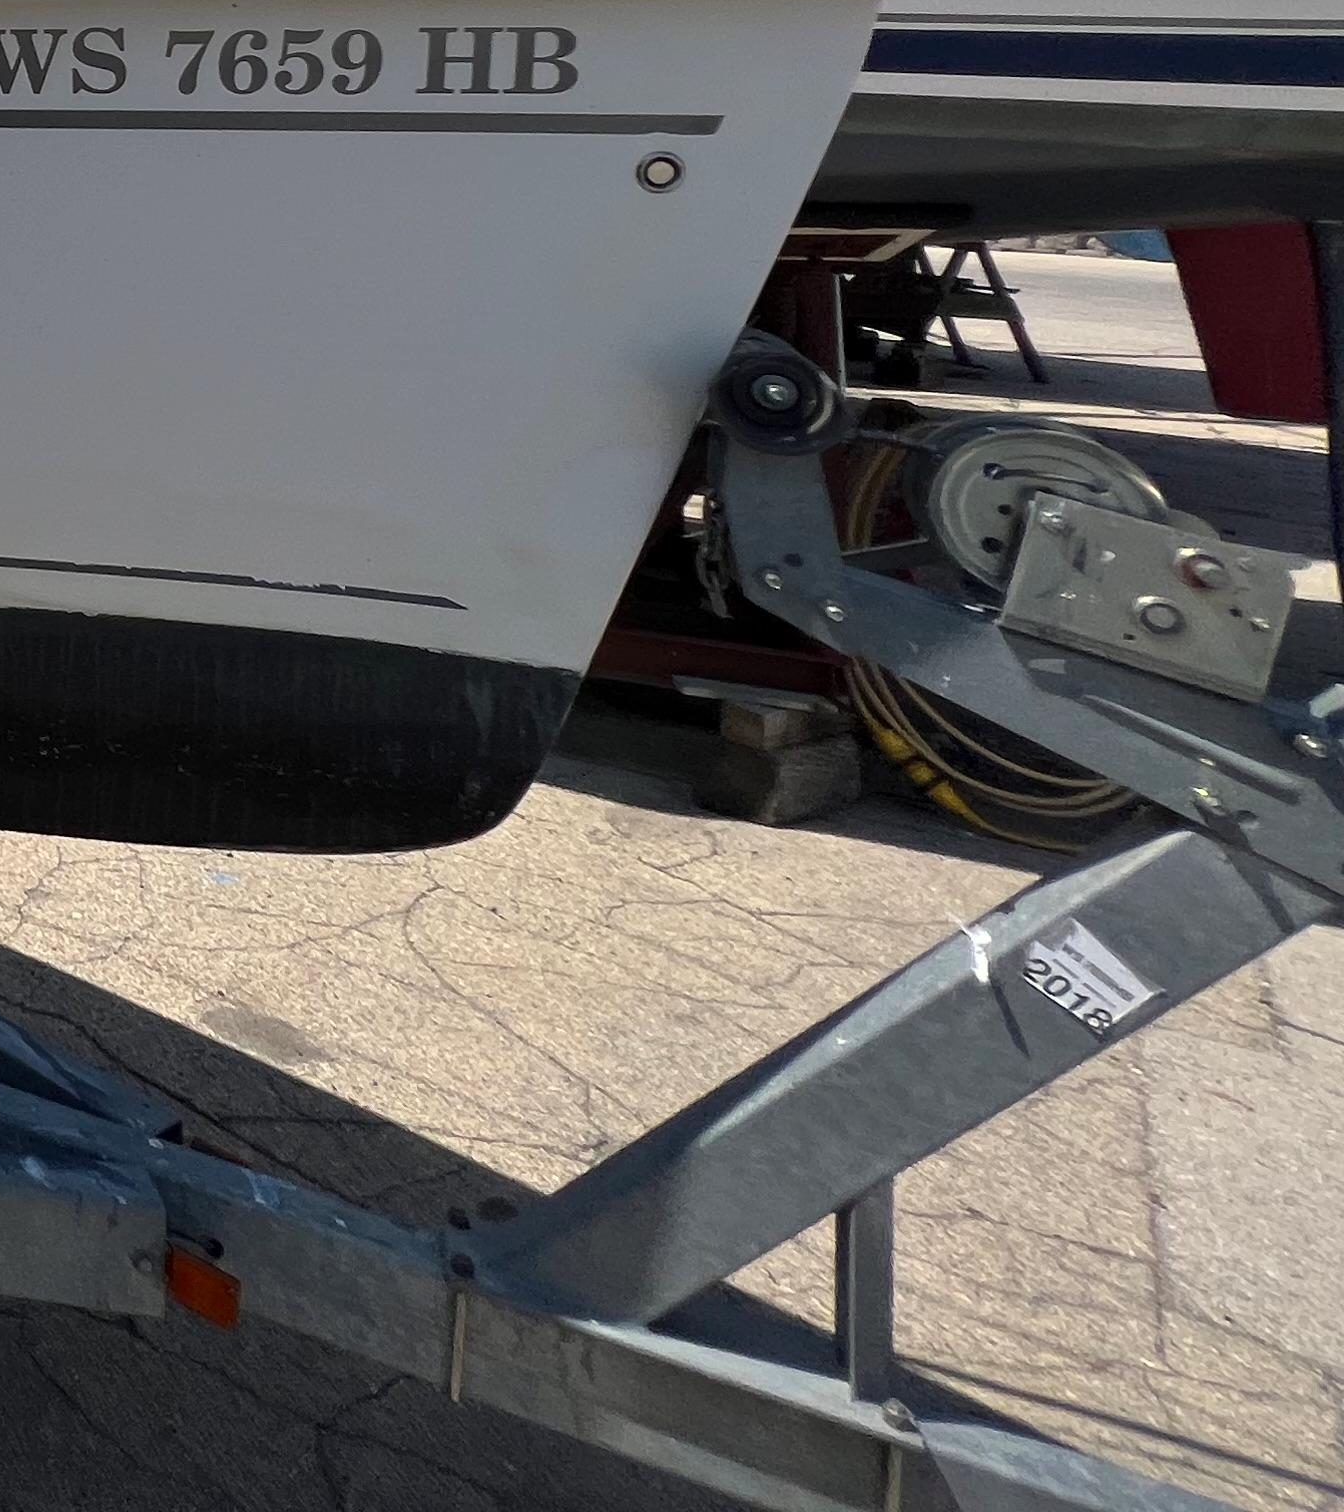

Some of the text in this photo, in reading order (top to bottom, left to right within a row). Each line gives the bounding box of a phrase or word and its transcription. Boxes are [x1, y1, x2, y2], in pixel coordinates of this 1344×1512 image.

[164, 29, 383, 96] 7659
[415, 26, 581, 96] HB
[1022, 958, 1113, 1036] 2018
